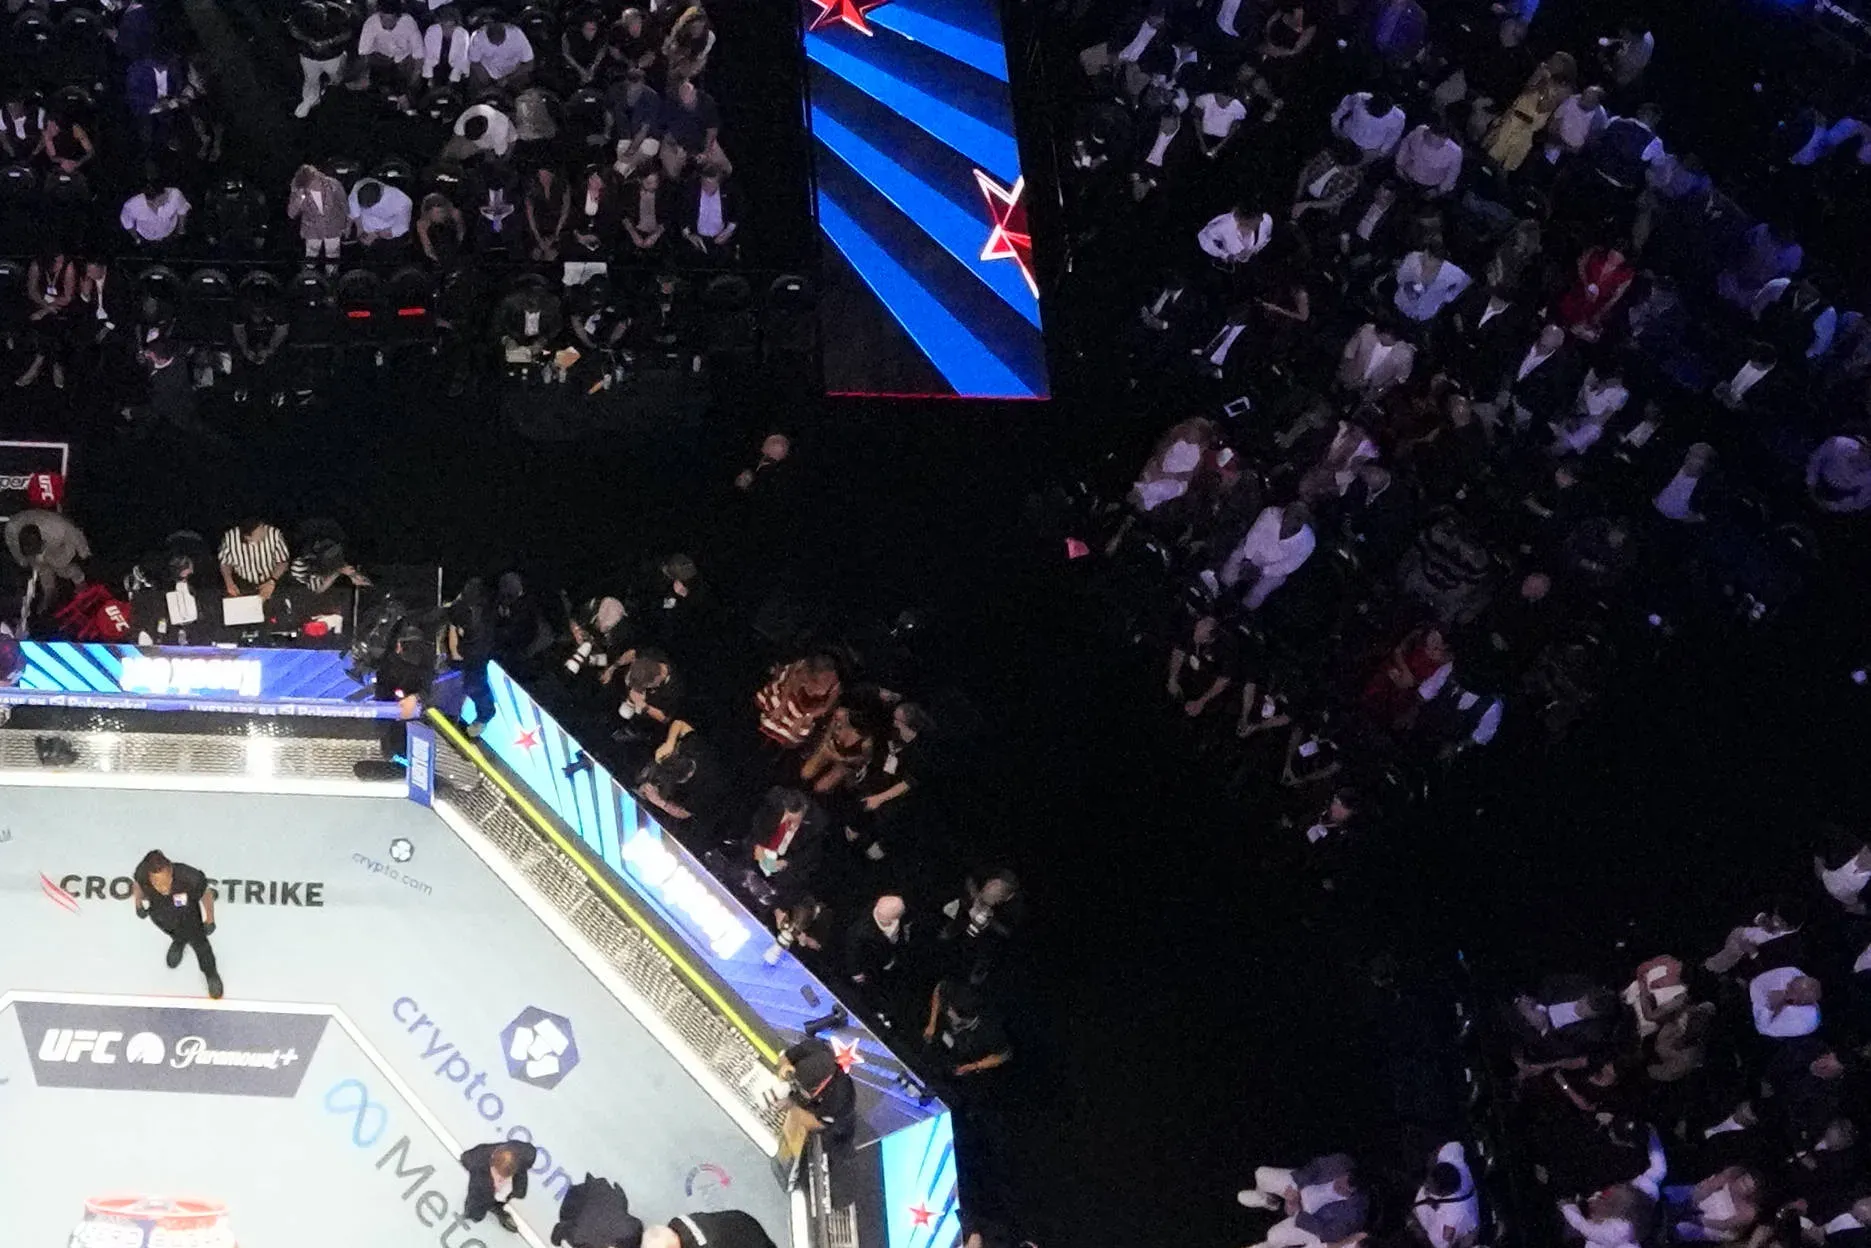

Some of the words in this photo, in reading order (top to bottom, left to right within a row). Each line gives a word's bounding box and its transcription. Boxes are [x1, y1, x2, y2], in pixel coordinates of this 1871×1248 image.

[37, 474, 54, 502] UFC
[104, 604, 130, 632] UFC
[66, 697, 147, 710] Polymarket
[297, 705, 378, 719] Polymarket
[352, 850, 433, 896] crypto.com
[60, 874, 325, 907] CROSTRIKE
[38, 1028, 123, 1064] UFC
[170, 1035, 300, 1069] Paramount+
